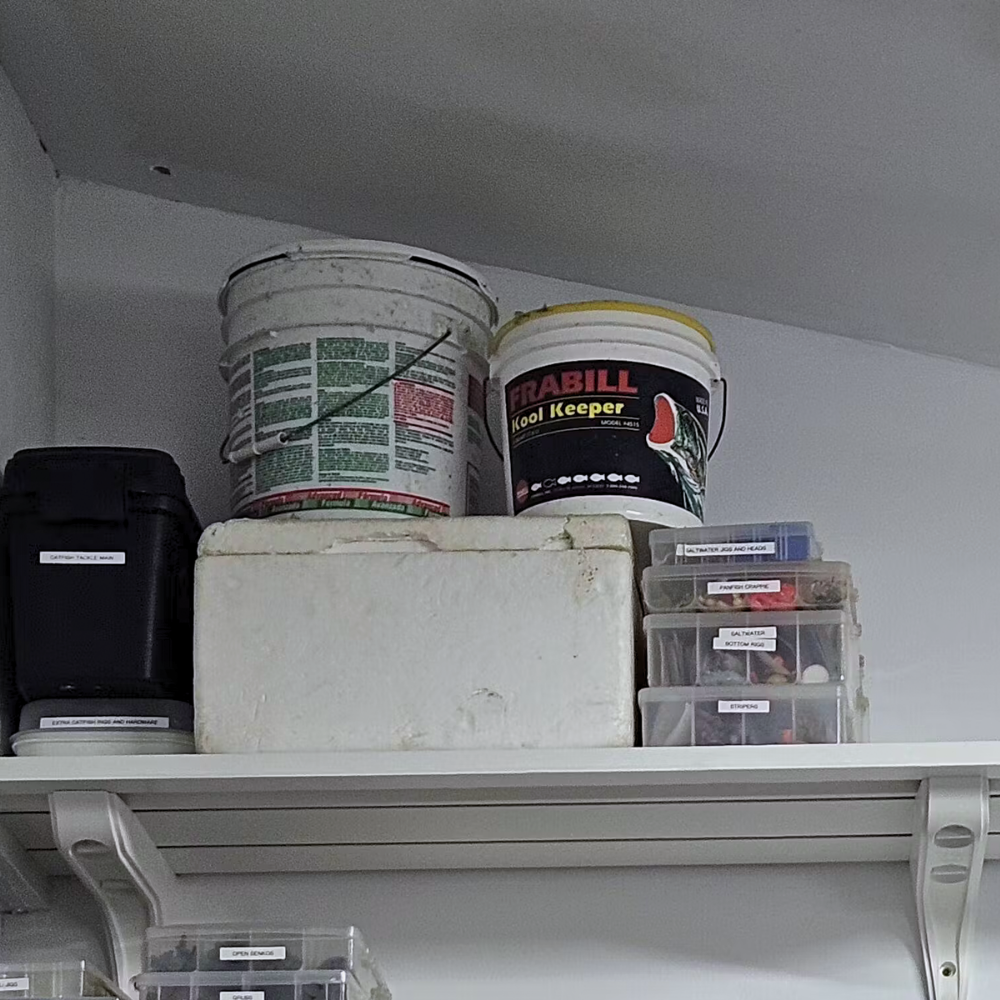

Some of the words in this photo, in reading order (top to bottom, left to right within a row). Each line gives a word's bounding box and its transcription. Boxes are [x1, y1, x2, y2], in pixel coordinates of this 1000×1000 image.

[510, 369, 638, 412] FRABILL
[511, 407, 543, 433] Kool
[550, 402, 624, 418] Keeper
